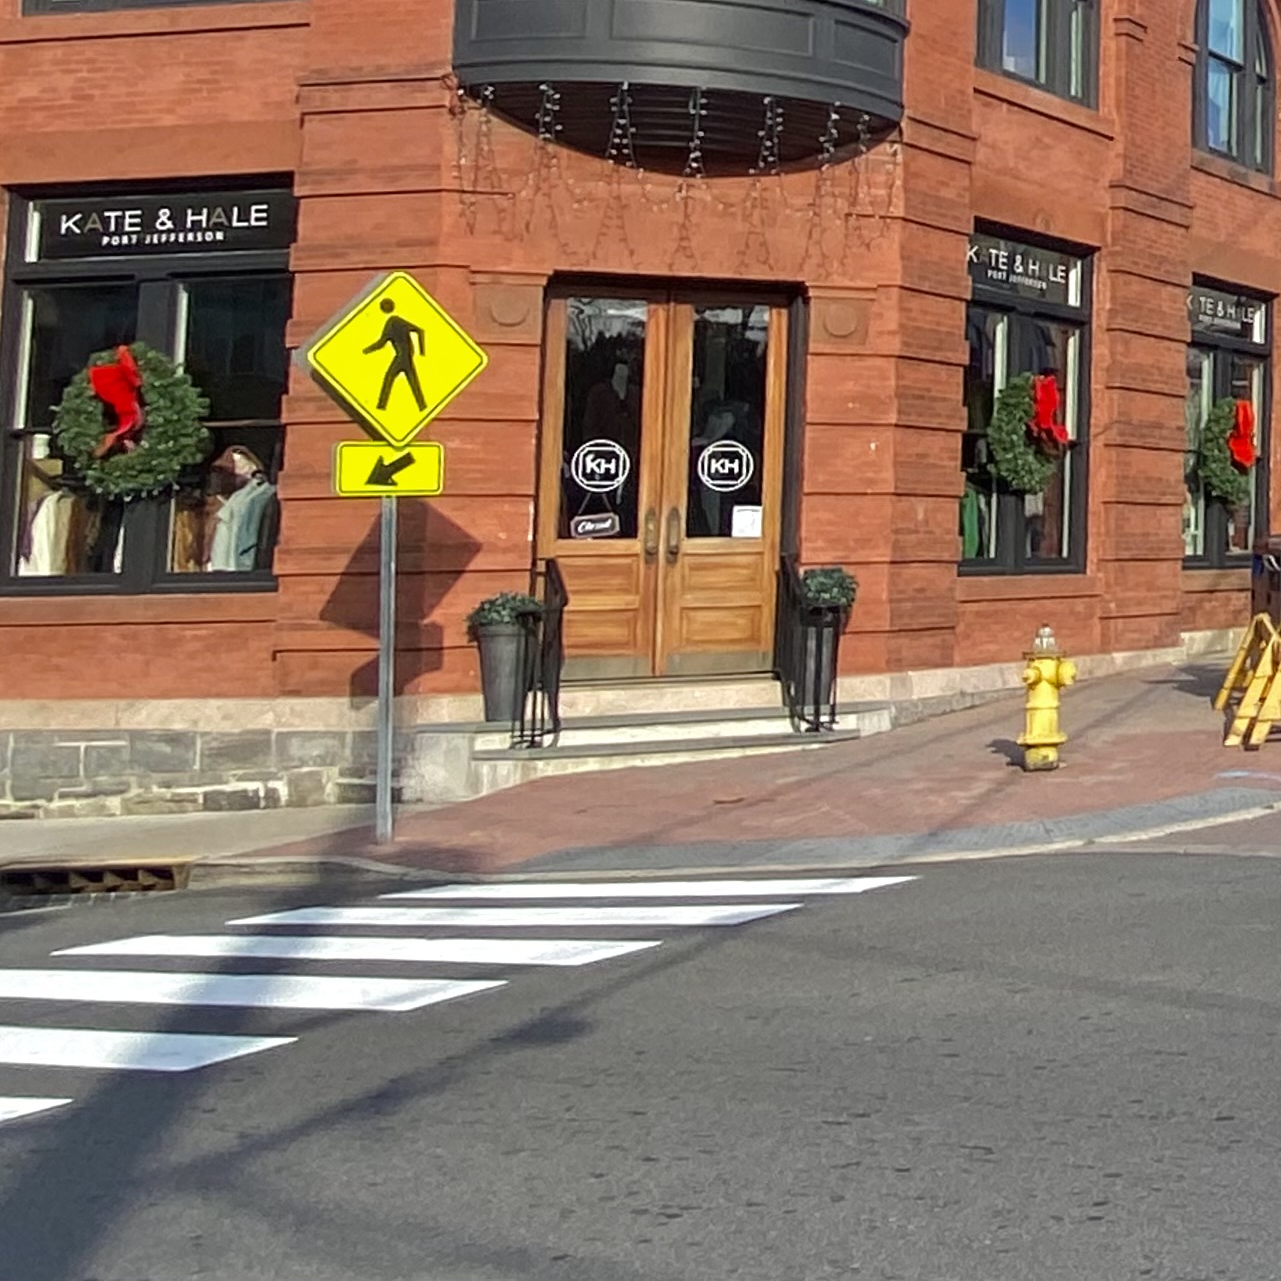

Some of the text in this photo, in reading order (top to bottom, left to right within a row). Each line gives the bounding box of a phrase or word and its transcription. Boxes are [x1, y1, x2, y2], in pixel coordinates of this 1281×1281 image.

[60, 204, 269, 234] KATE & HALE
[102, 230, 225, 246] PORT JEFFERSON
[966, 245, 1067, 284] KTE & HLE
[1227, 305, 1255, 323] HLE
[585, 458, 616, 474] KH
[711, 459, 739, 474] KH
